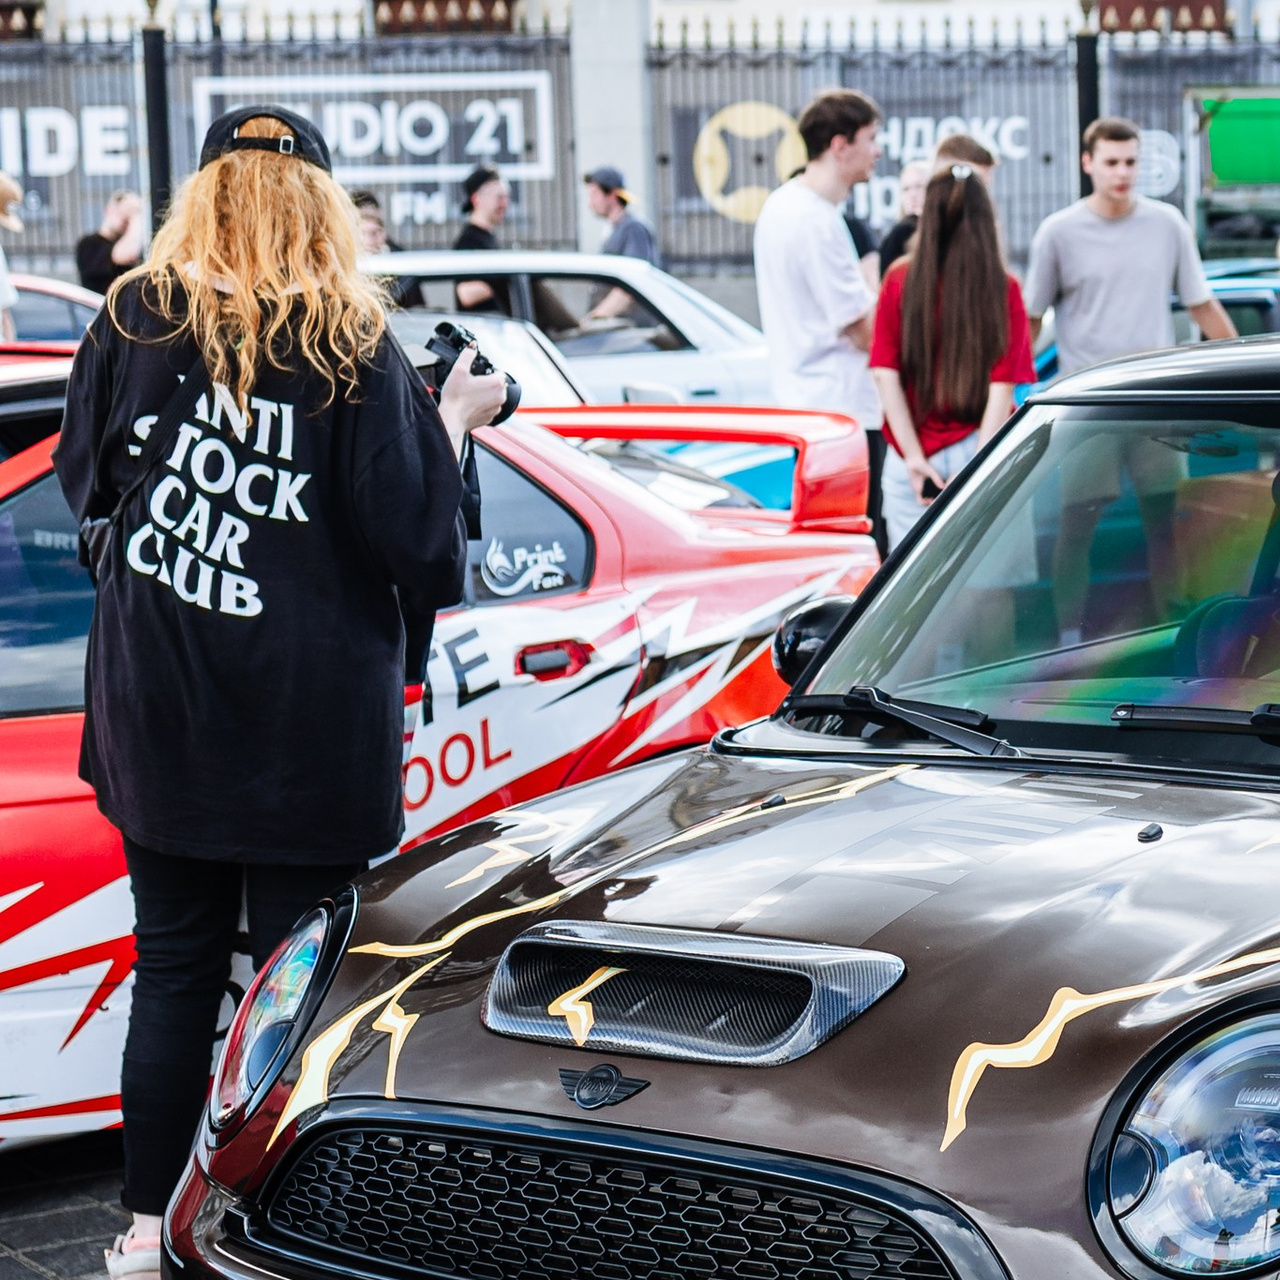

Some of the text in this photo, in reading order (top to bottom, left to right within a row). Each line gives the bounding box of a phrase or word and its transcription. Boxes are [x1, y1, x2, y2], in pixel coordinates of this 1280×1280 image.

[464, 97, 526, 157] 21
[391, 190, 448, 225] FM
[150, 475, 250, 569] CAR
[513, 541, 566, 571] Print
